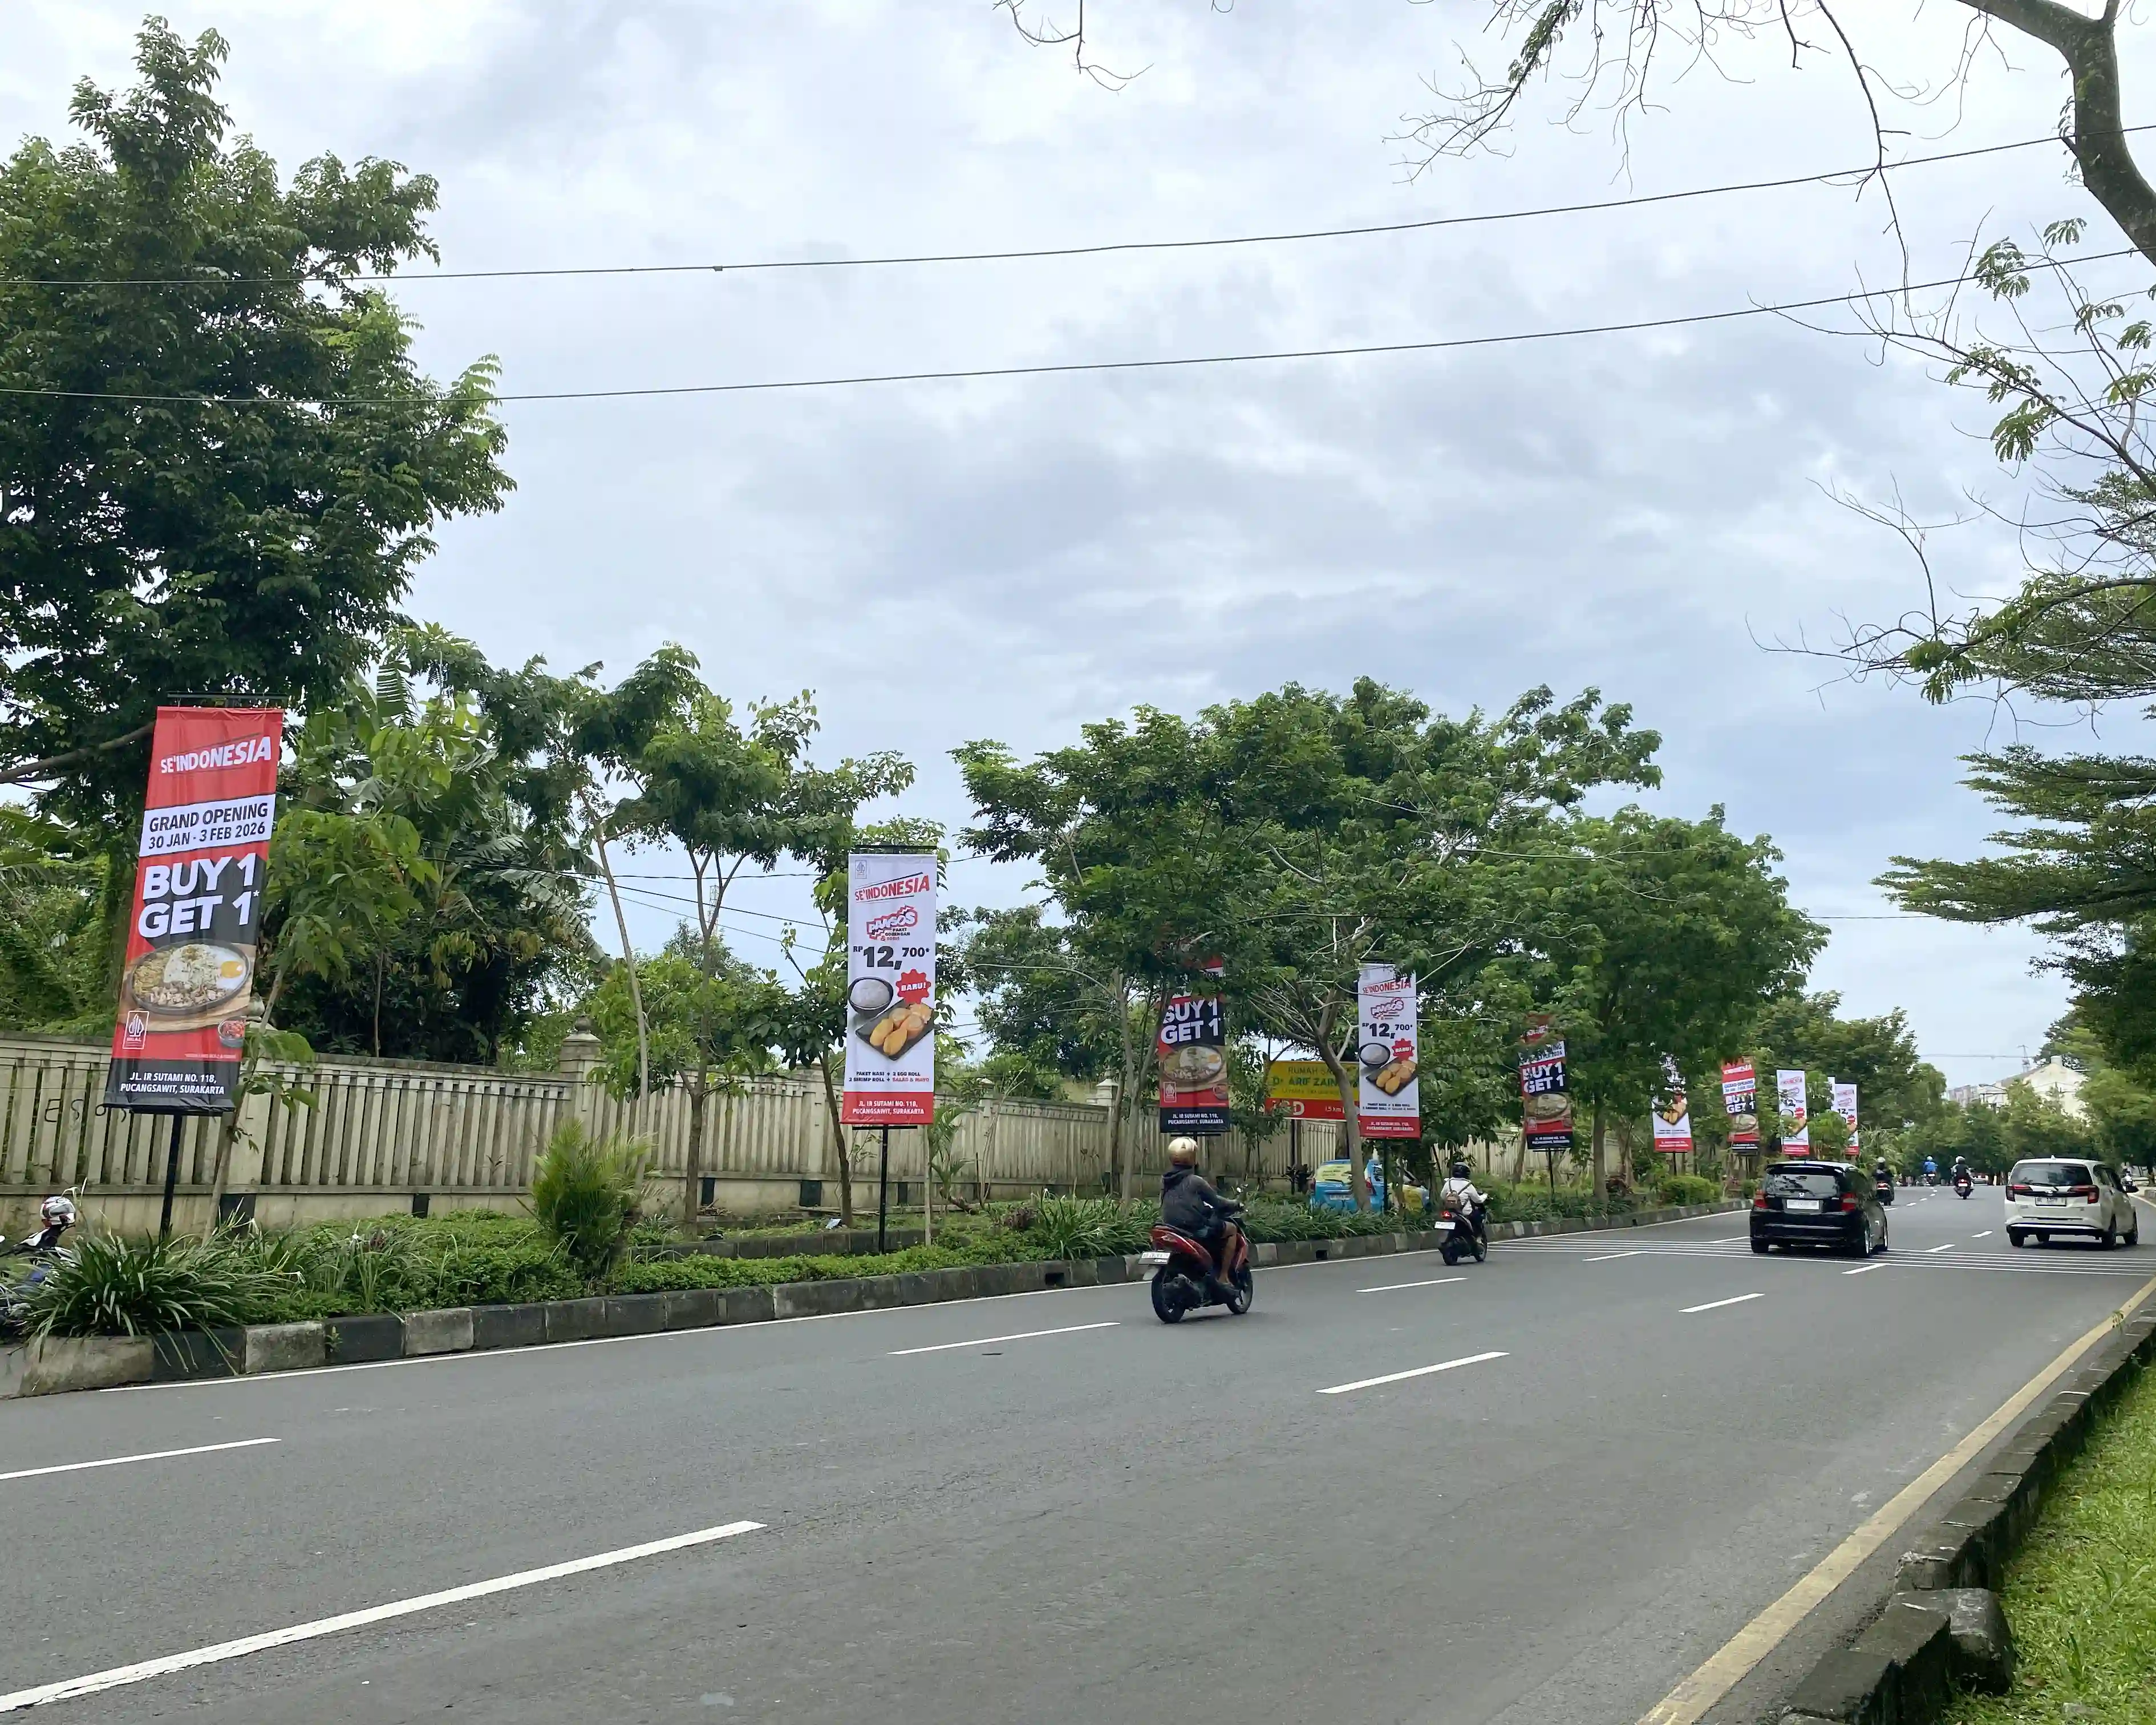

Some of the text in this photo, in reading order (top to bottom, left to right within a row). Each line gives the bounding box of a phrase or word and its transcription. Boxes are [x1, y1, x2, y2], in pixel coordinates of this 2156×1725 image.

[160, 736, 271, 774] SE'INDONESIA
[149, 802, 268, 832] GRAND OPENING
[148, 835, 164, 849] 30
[167, 832, 190, 848] JAN
[199, 829, 206, 842] 3
[210, 827, 232, 841] FEB
[235, 821, 266, 838] 2026
[143, 852, 256, 900] BUY 1
[855, 875, 930, 901] SE'INDONESIA
[137, 895, 223, 938] GET
[1207, 997, 1218, 1017] 1
[1161, 1019, 1204, 1044] GET
[129, 1072, 141, 1080] JL.
[153, 1072, 183, 1082] SUTAMI
[185, 1074, 198, 1082] NO.
[200, 1074, 217, 1083] 118,
[1522, 1062, 1562, 1080] BUY 1
[120, 1084, 224, 1094] PUCANGSAWIT, SURAKARTA
[1523, 1076, 1553, 1093] GET
